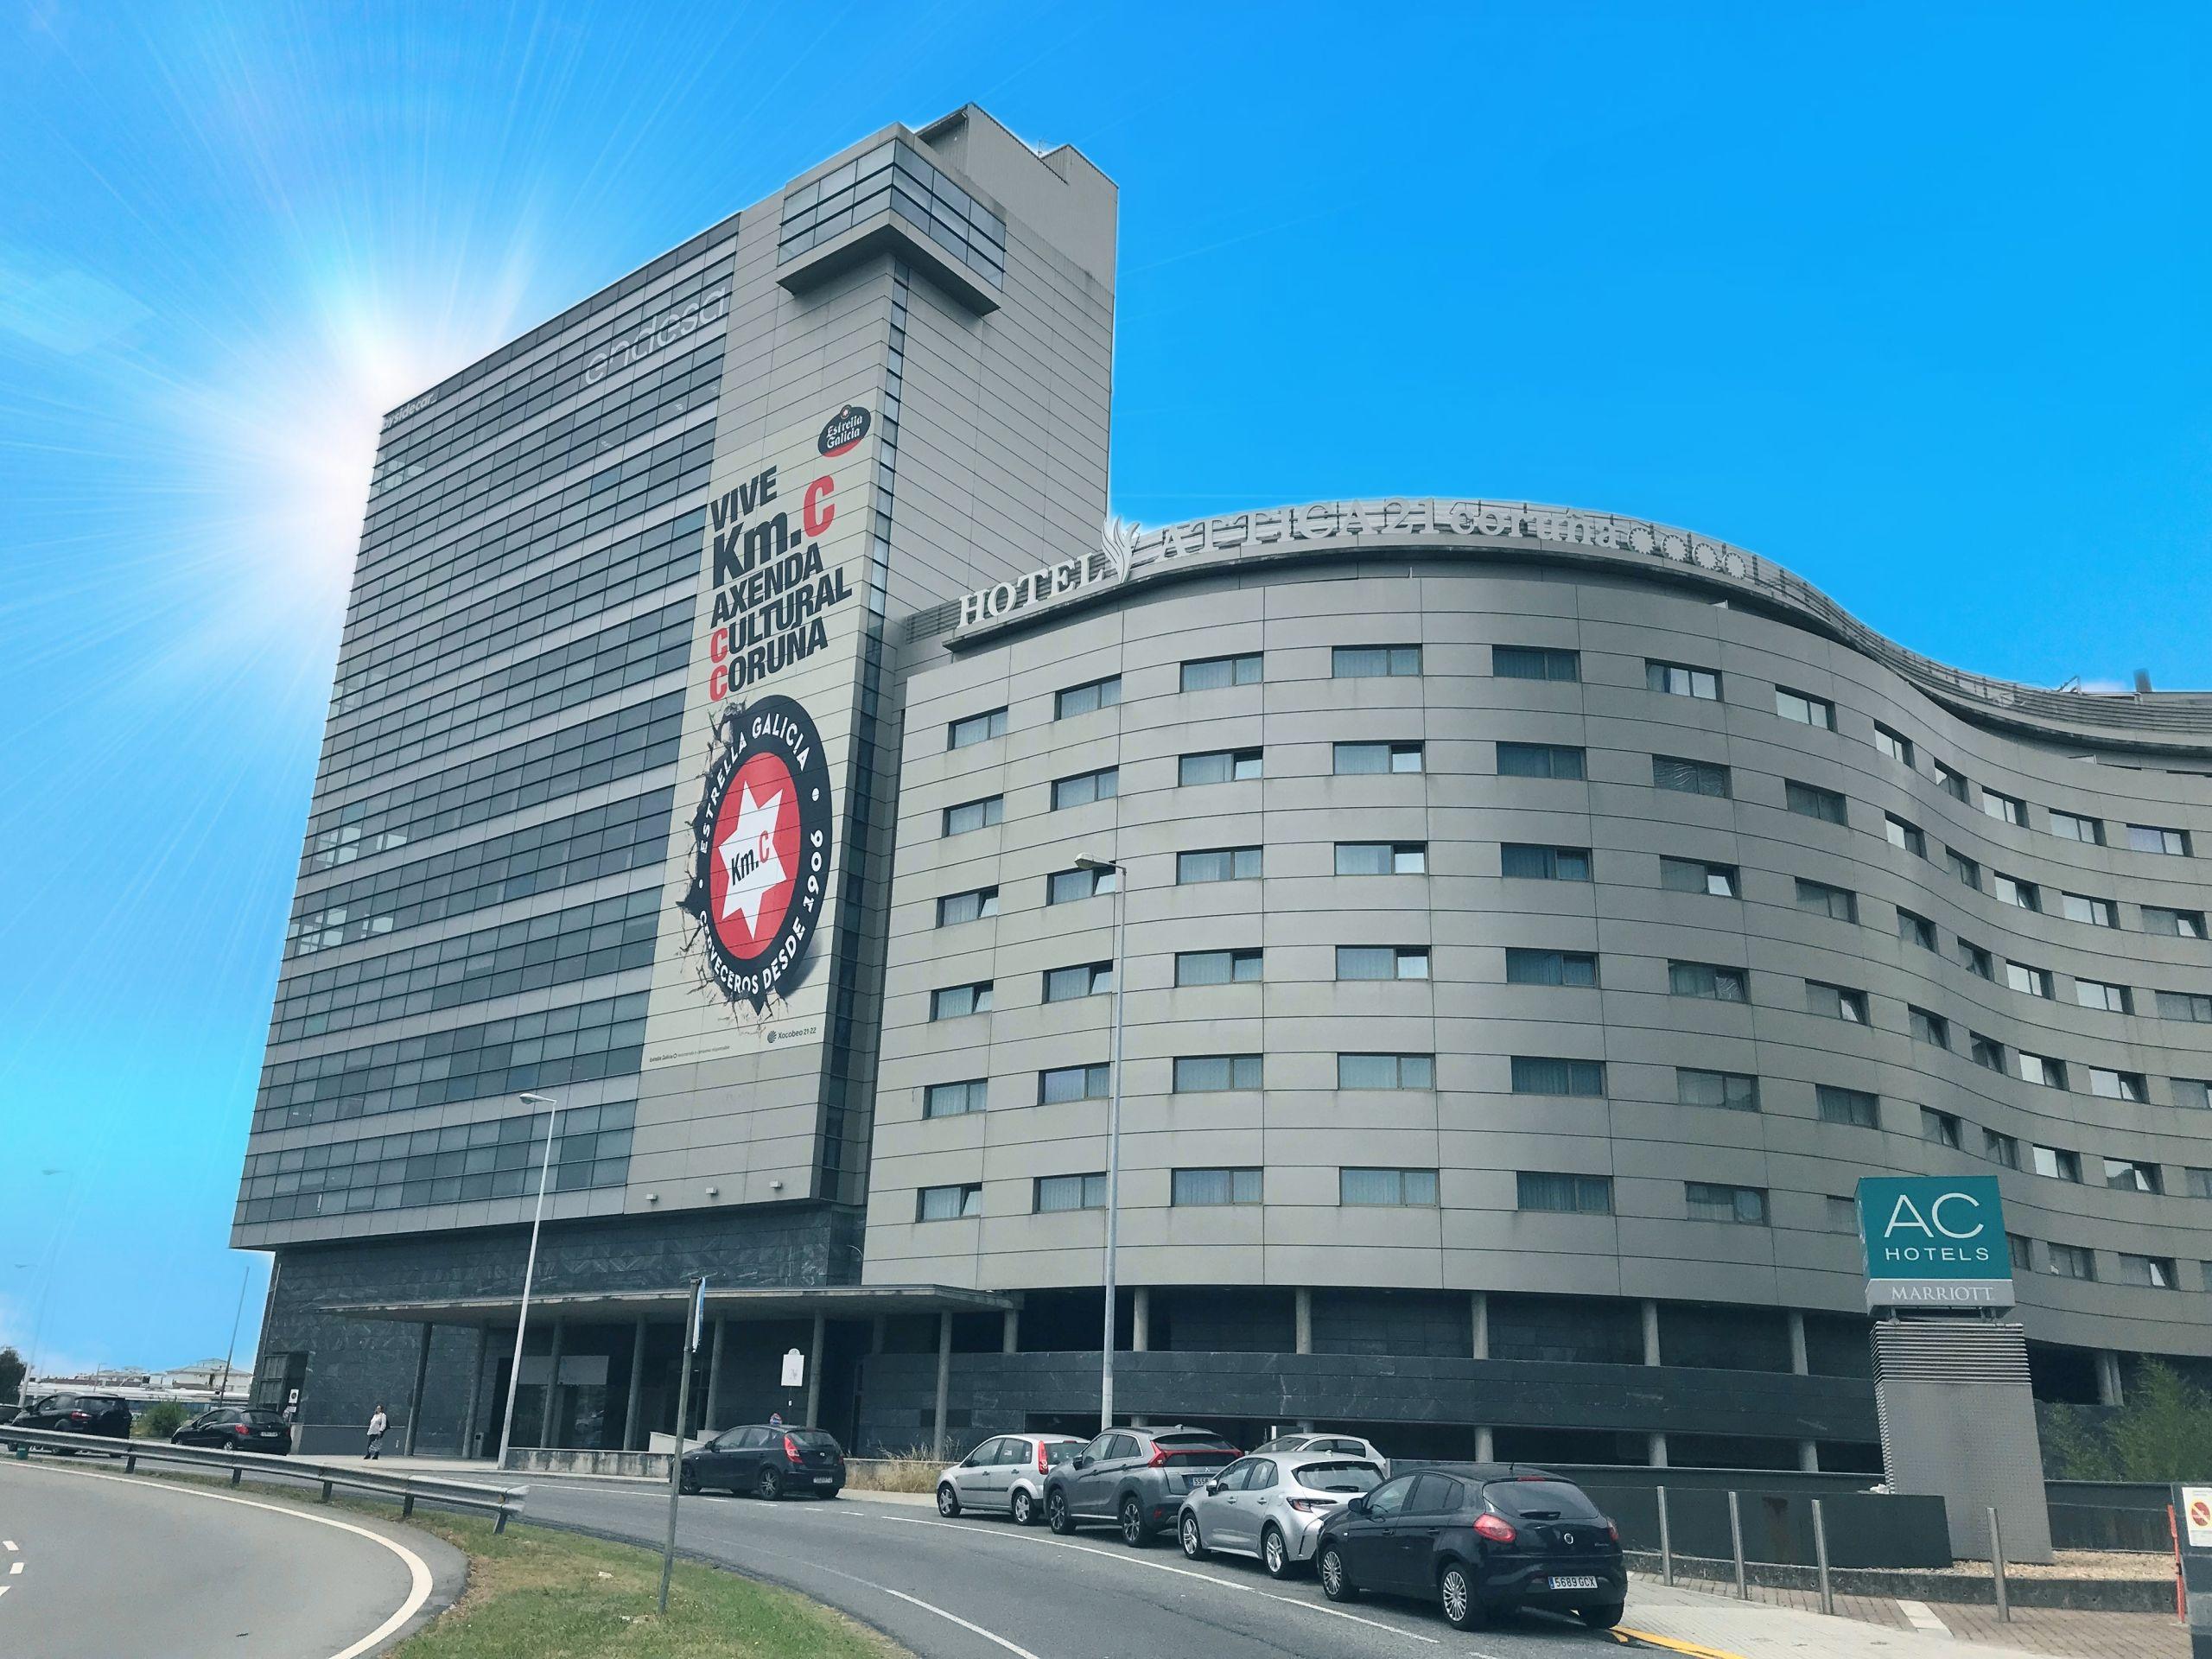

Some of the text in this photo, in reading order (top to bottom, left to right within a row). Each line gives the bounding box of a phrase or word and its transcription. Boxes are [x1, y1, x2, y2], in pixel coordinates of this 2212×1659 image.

[585, 286, 726, 385] endesa
[826, 415, 863, 438] Estrella
[827, 428, 861, 448] Galicia
[710, 465, 778, 532] VIVE
[710, 542, 823, 629] AXENDA
[710, 567, 853, 664] CULTURAL
[956, 552, 1105, 629] HOTEL
[701, 713, 810, 854] ESTRELLA GALICIA
[763, 916, 806, 990] DESDE
[803, 830, 823, 913] 1906
[1884, 1192, 1985, 1239] AC
[1885, 1247, 1989, 1261] HOTELS
[1891, 1286, 1994, 1301] MARRIOTT
